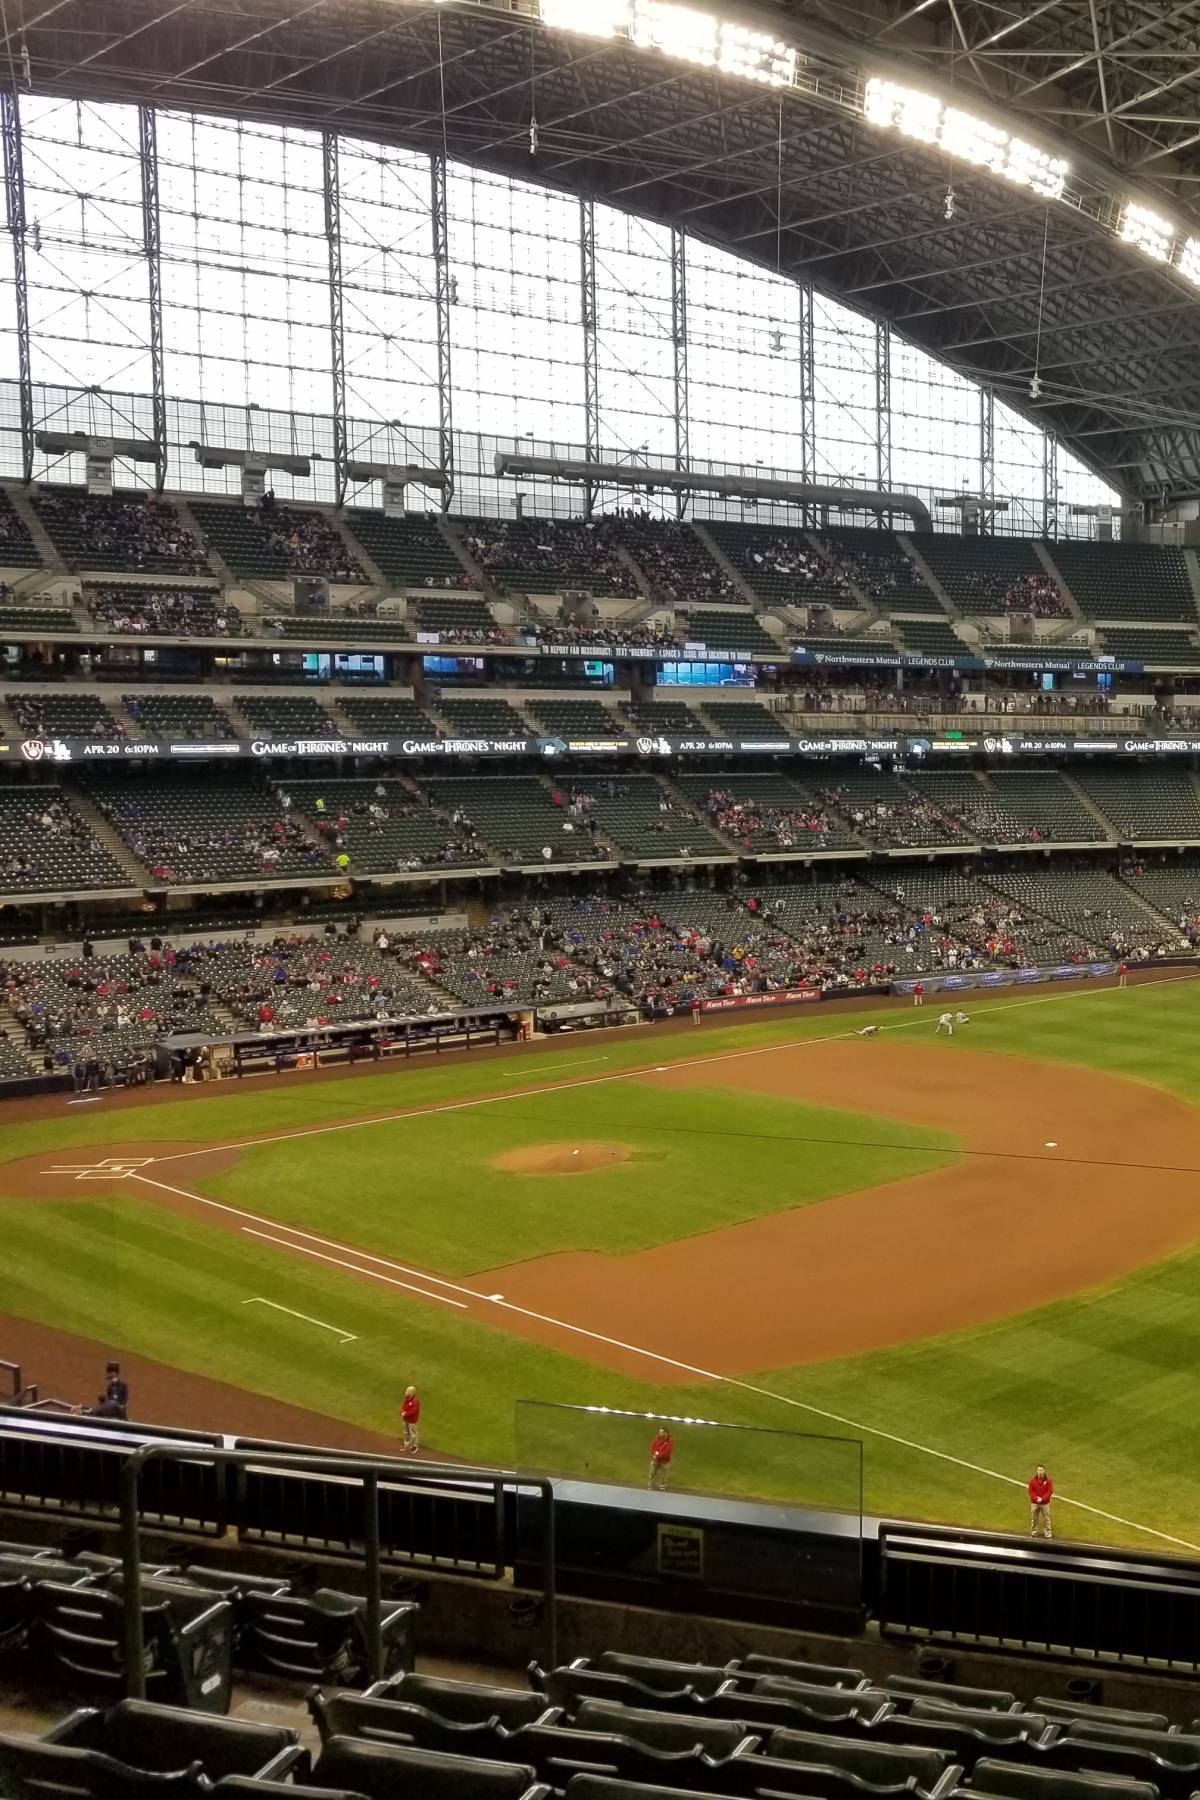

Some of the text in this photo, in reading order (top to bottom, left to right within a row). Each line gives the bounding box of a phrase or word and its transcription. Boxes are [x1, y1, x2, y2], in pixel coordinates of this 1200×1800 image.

[615, 648, 628, 657] TEXT
[825, 655, 874, 664] Northwestern
[876, 656, 901, 665] Mutual
[938, 658, 955, 666] CLUB
[994, 660, 1043, 669] Northwestern
[1045, 661, 1070, 669] Mutual
[1078, 662, 1107, 670] LEGENDS
[84, 745, 159, 754] APR 20 6:10PM
[251, 741, 288, 755] GAME
[294, 741, 347, 754] THRONES
[352, 742, 388, 752] NIGHT
[403, 740, 436, 753] GAME
[442, 740, 489, 752] THRONES
[494, 741, 527, 751] NIGHT
[708, 742, 733, 750] 6:10PM
[799, 740, 825, 751] GAME
[830, 740, 867, 751] THRONES
[872, 741, 898, 750] NIGHT
[1125, 741, 1149, 750] GAME
[1153, 741, 1187, 750] THRONES
